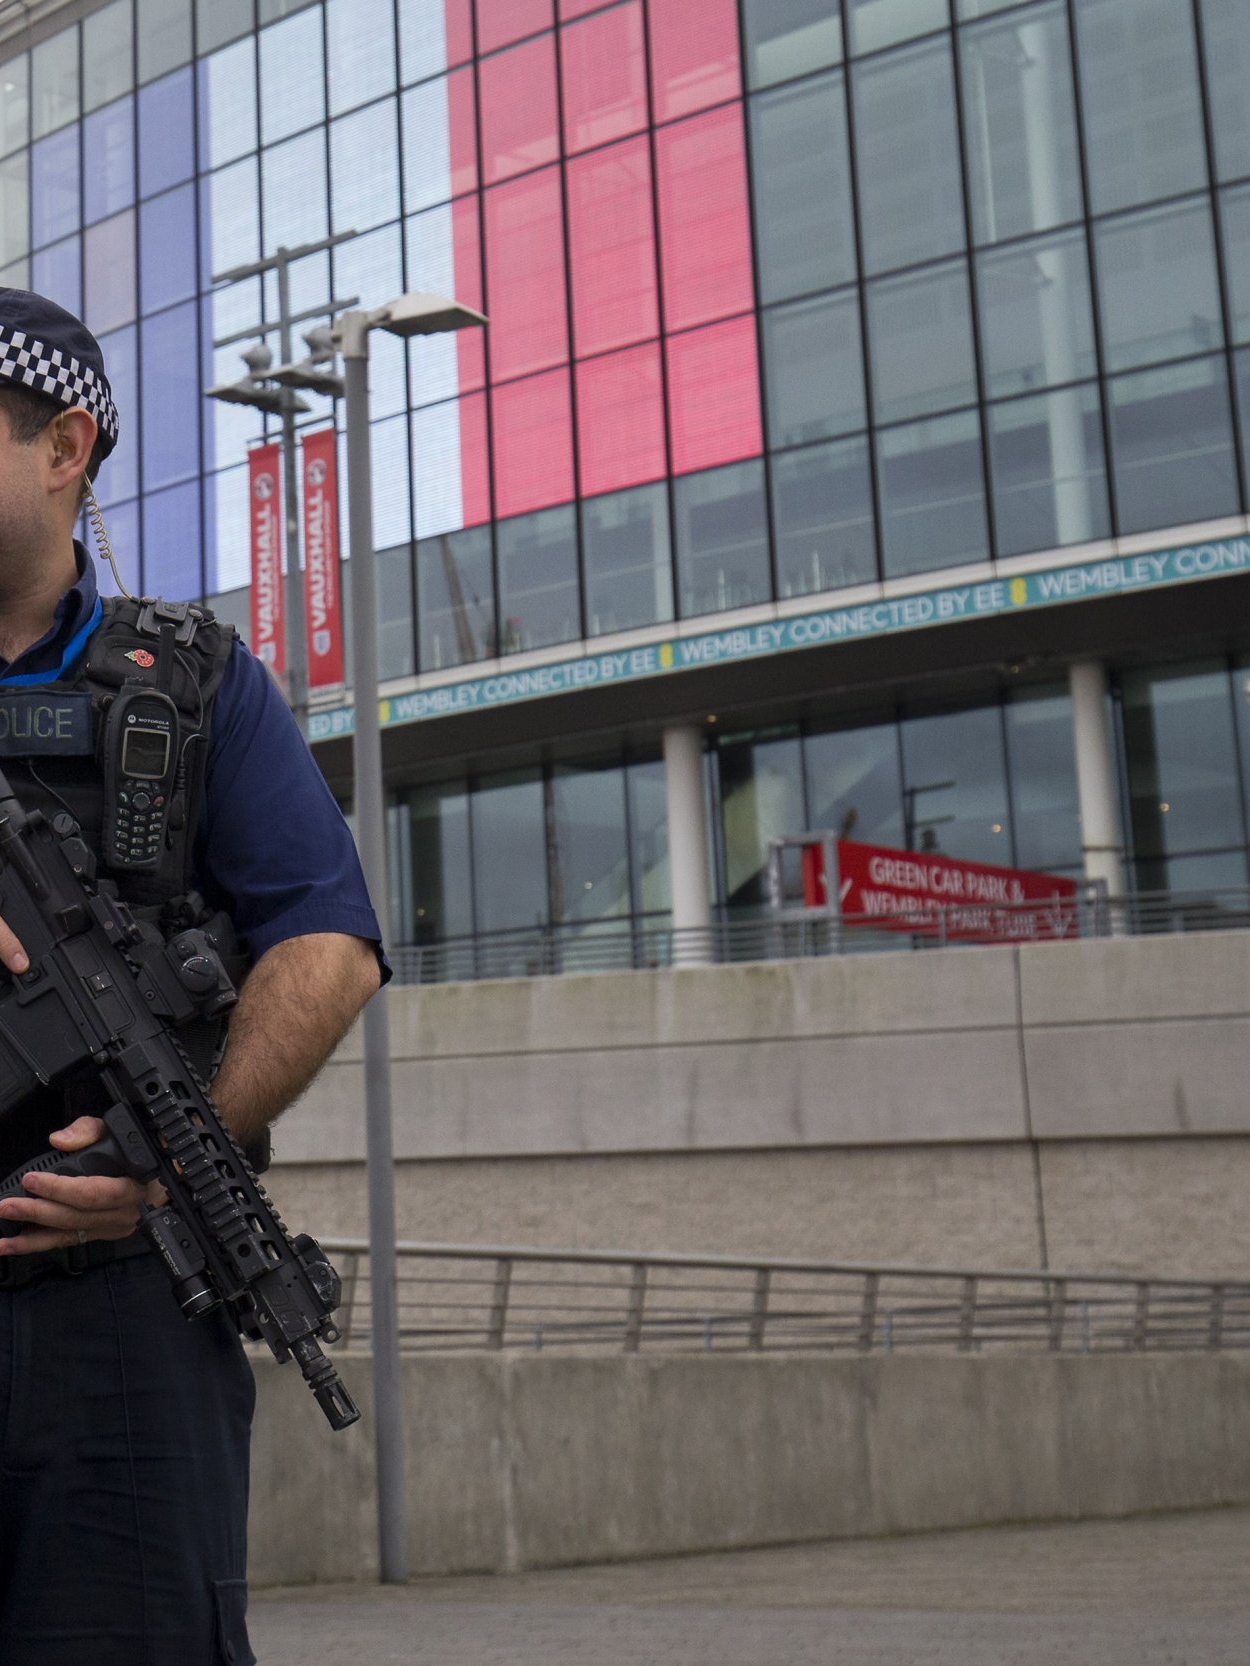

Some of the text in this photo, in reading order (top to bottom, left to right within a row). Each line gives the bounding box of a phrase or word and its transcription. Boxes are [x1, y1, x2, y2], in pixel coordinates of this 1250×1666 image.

[255, 502, 273, 640] VAUXHALL
[308, 488, 327, 629] VAUXHALL
[1036, 553, 1170, 600] WEMBLEY
[681, 582, 1005, 664] WEMBLEY CONNECTED BY EE
[396, 647, 656, 718] WEMBLEY CONNECTED BY EE
[308, 714, 331, 738] ED
[869, 855, 928, 891] GREEN
[928, 865, 964, 898] CAR
[965, 870, 1009, 904] PARK
